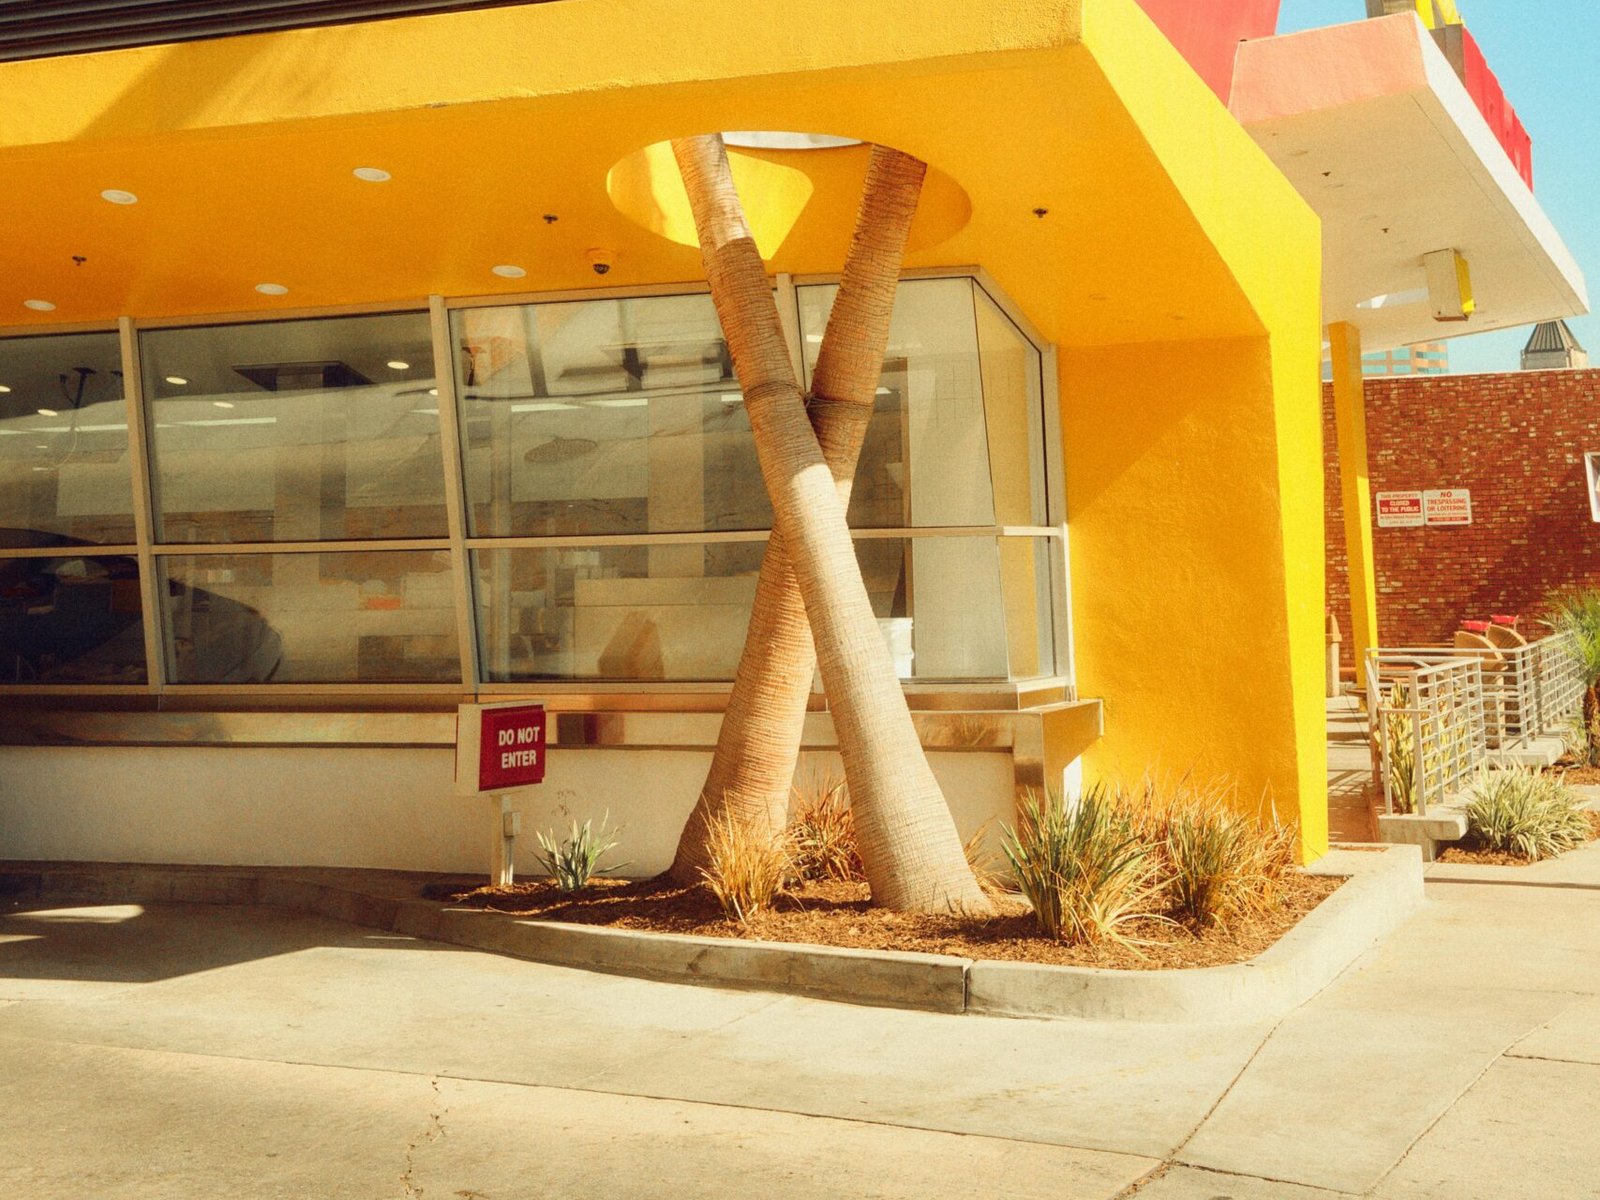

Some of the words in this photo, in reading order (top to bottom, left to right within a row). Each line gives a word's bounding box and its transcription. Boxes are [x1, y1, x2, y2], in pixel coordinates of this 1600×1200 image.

[499, 729, 515, 746] DO
[517, 726, 540, 744] NOT
[502, 750, 537, 769] ENTER
